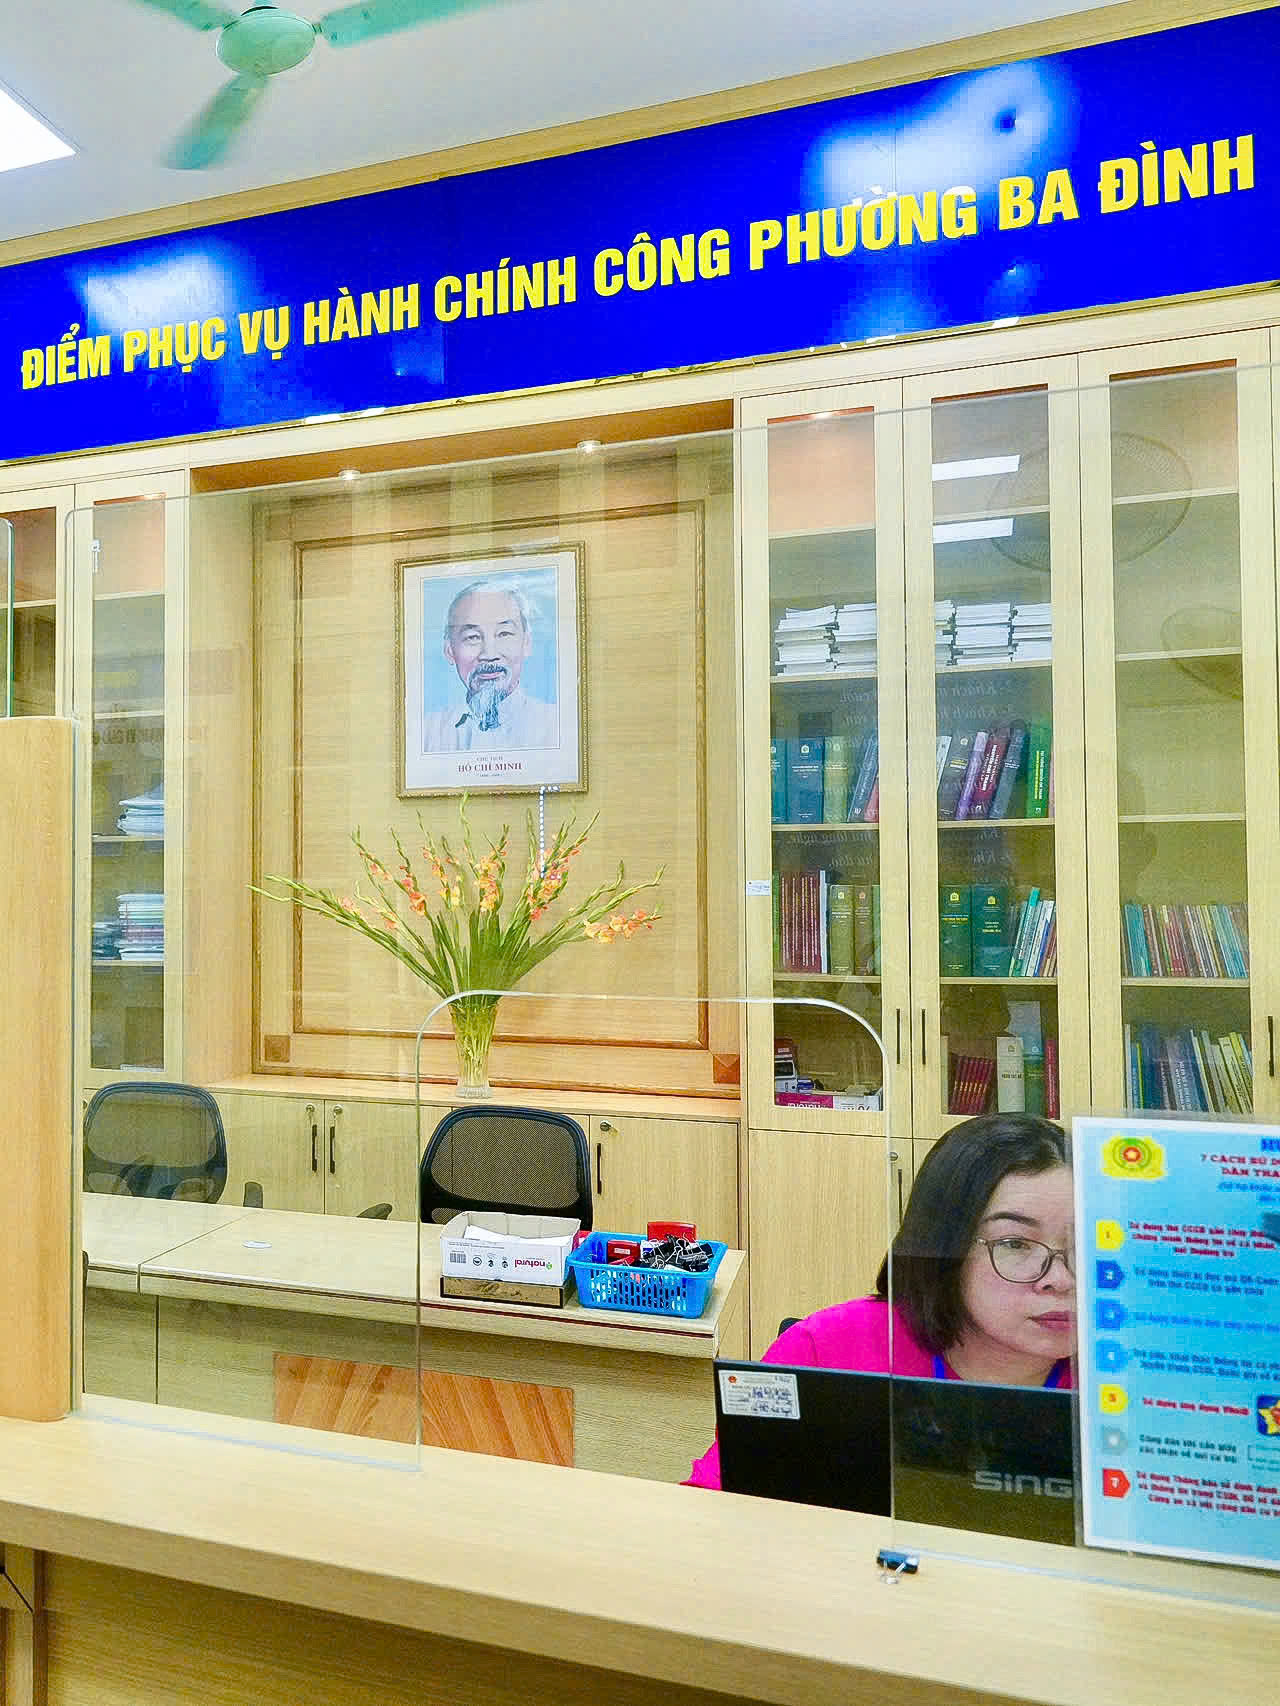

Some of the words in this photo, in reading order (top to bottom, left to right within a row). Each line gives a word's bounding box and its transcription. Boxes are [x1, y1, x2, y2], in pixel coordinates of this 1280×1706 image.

[22, 323, 111, 389] ĐIỂM
[124, 317, 226, 374] PHỤC
[239, 305, 290, 361] VỤ
[304, 282, 420, 346] HÀNH
[434, 257, 577, 322] CHÍNH
[595, 231, 730, 297] CÔNG
[749, 185, 977, 270] PHƯỜNG
[998, 170, 1080, 230] BA
[1098, 133, 1255, 213] ĐÌNH
[458, 763, 472, 773] HỒ
[474, 763, 493, 772] CHÍ
[495, 763, 522, 771] MINH
[514, 1258, 546, 1268] natural
[973, 1470, 1074, 1499] SING
